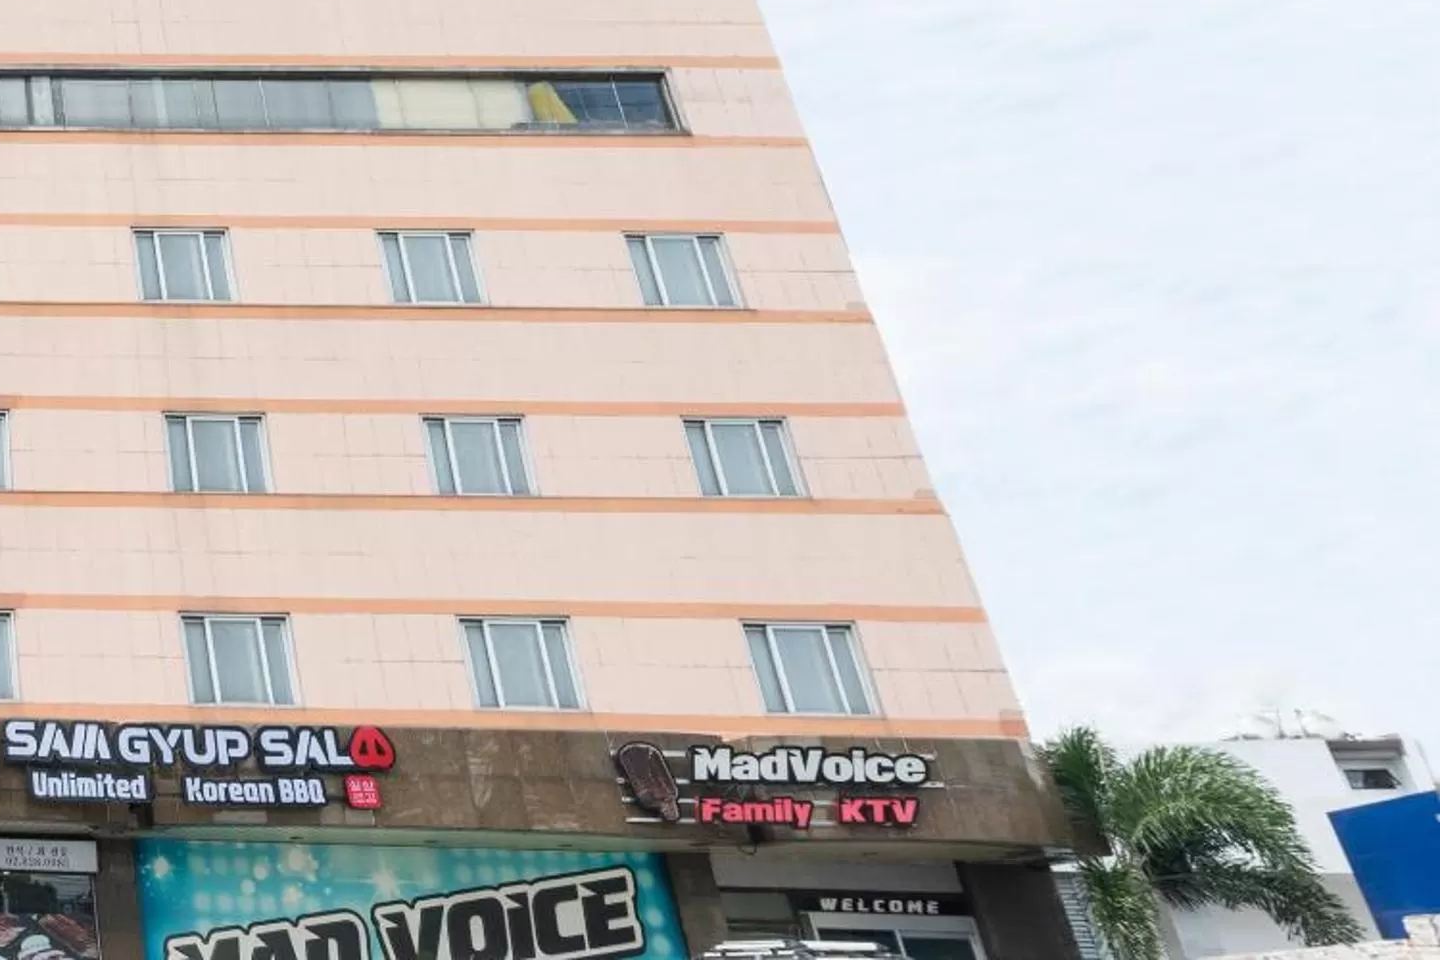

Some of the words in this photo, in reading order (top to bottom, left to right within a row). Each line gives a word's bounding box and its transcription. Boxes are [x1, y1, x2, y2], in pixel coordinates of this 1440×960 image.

[693, 747, 927, 783] MadVoice
[32, 772, 147, 800] Unlimited
[185, 776, 276, 804] Korean
[279, 778, 326, 804] BBQ
[702, 798, 811, 828] Family
[841, 798, 917, 824] KTV
[380, 875, 635, 960] VOICE
[820, 897, 941, 915] WELCOME
